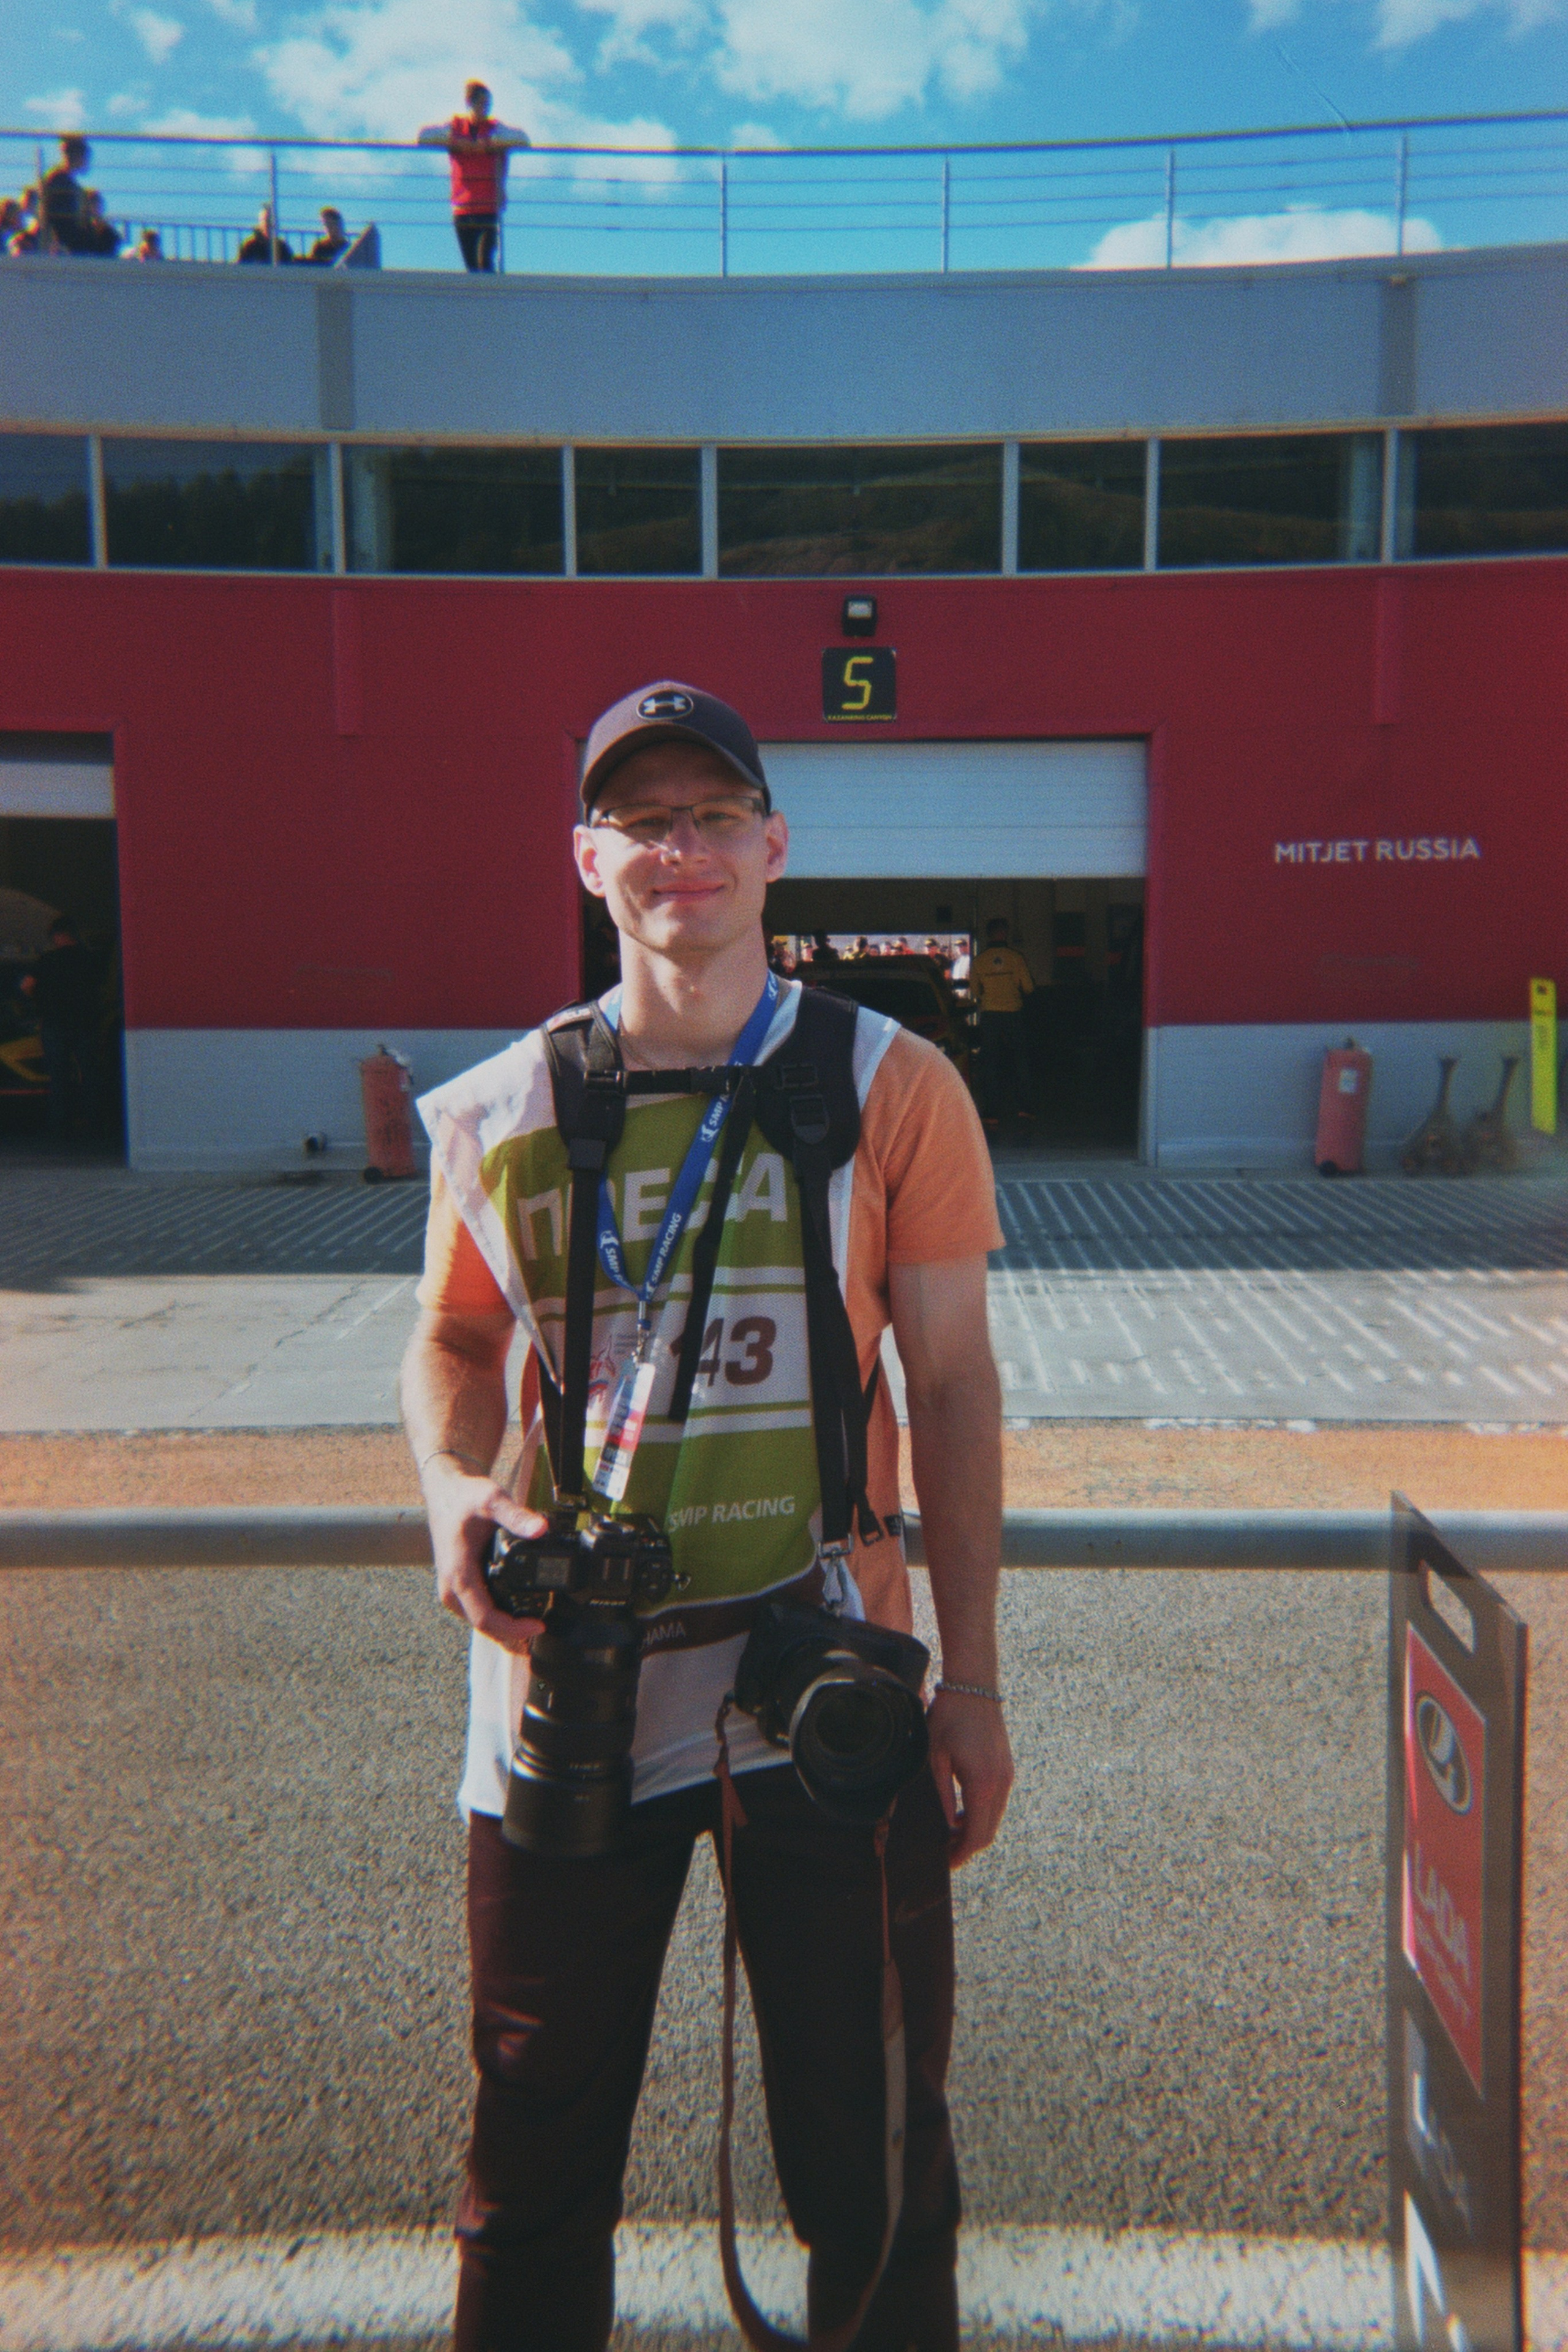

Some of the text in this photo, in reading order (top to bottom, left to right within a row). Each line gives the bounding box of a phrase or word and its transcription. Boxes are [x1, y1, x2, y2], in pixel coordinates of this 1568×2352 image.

[841, 656, 874, 710] 5
[1275, 838, 1480, 863] MITJET RUSSIA
[516, 1152, 788, 1261] ПЕСА
[651, 1212, 682, 1284] SMP RACING
[669, 1315, 777, 1387] 43
[712, 1496, 794, 1524] RACING
[641, 1621, 687, 1651] HAMA
[1414, 1840, 1471, 1987] LADA
